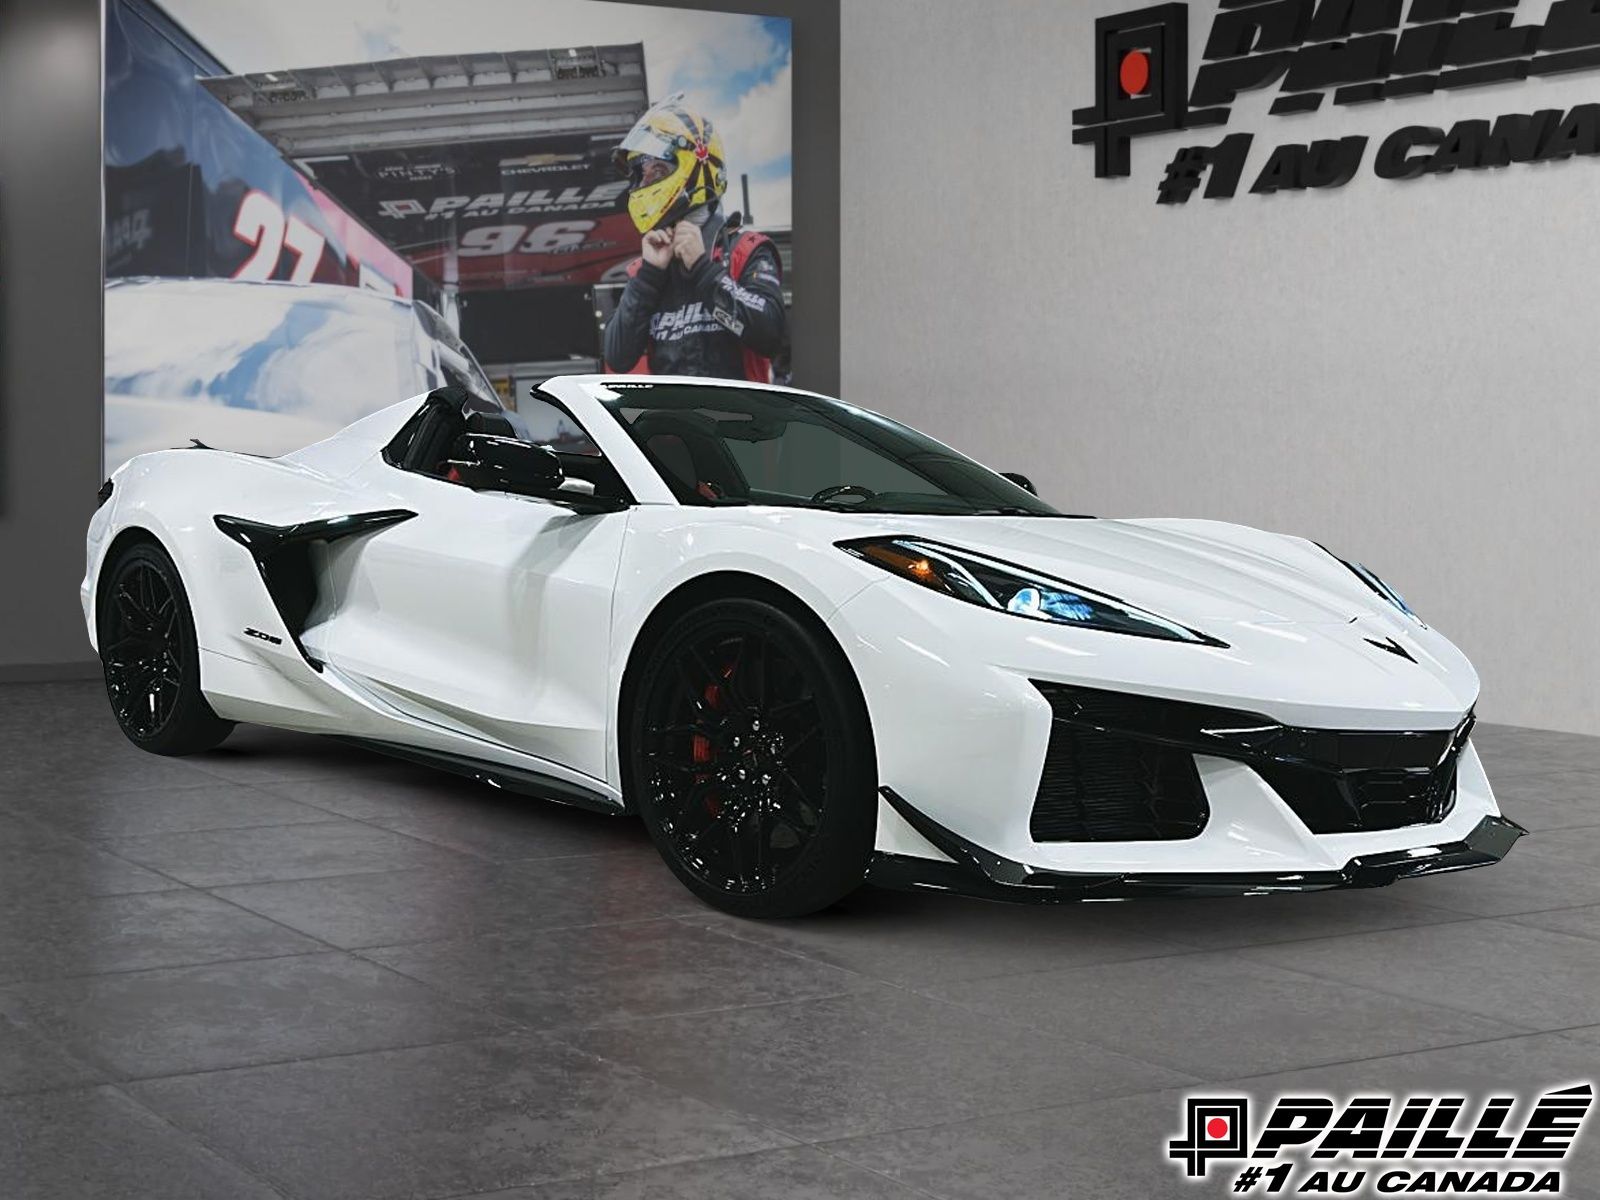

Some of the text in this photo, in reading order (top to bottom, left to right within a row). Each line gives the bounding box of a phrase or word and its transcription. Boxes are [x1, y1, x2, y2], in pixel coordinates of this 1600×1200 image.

[501, 164, 590, 175] CHEVROLET
[1156, 132, 1254, 204] #1
[1248, 135, 1369, 193] AU
[462, 208, 500, 218] AU
[507, 200, 616, 215] CANADA
[231, 189, 326, 284] 27
[458, 220, 596, 257] 96
